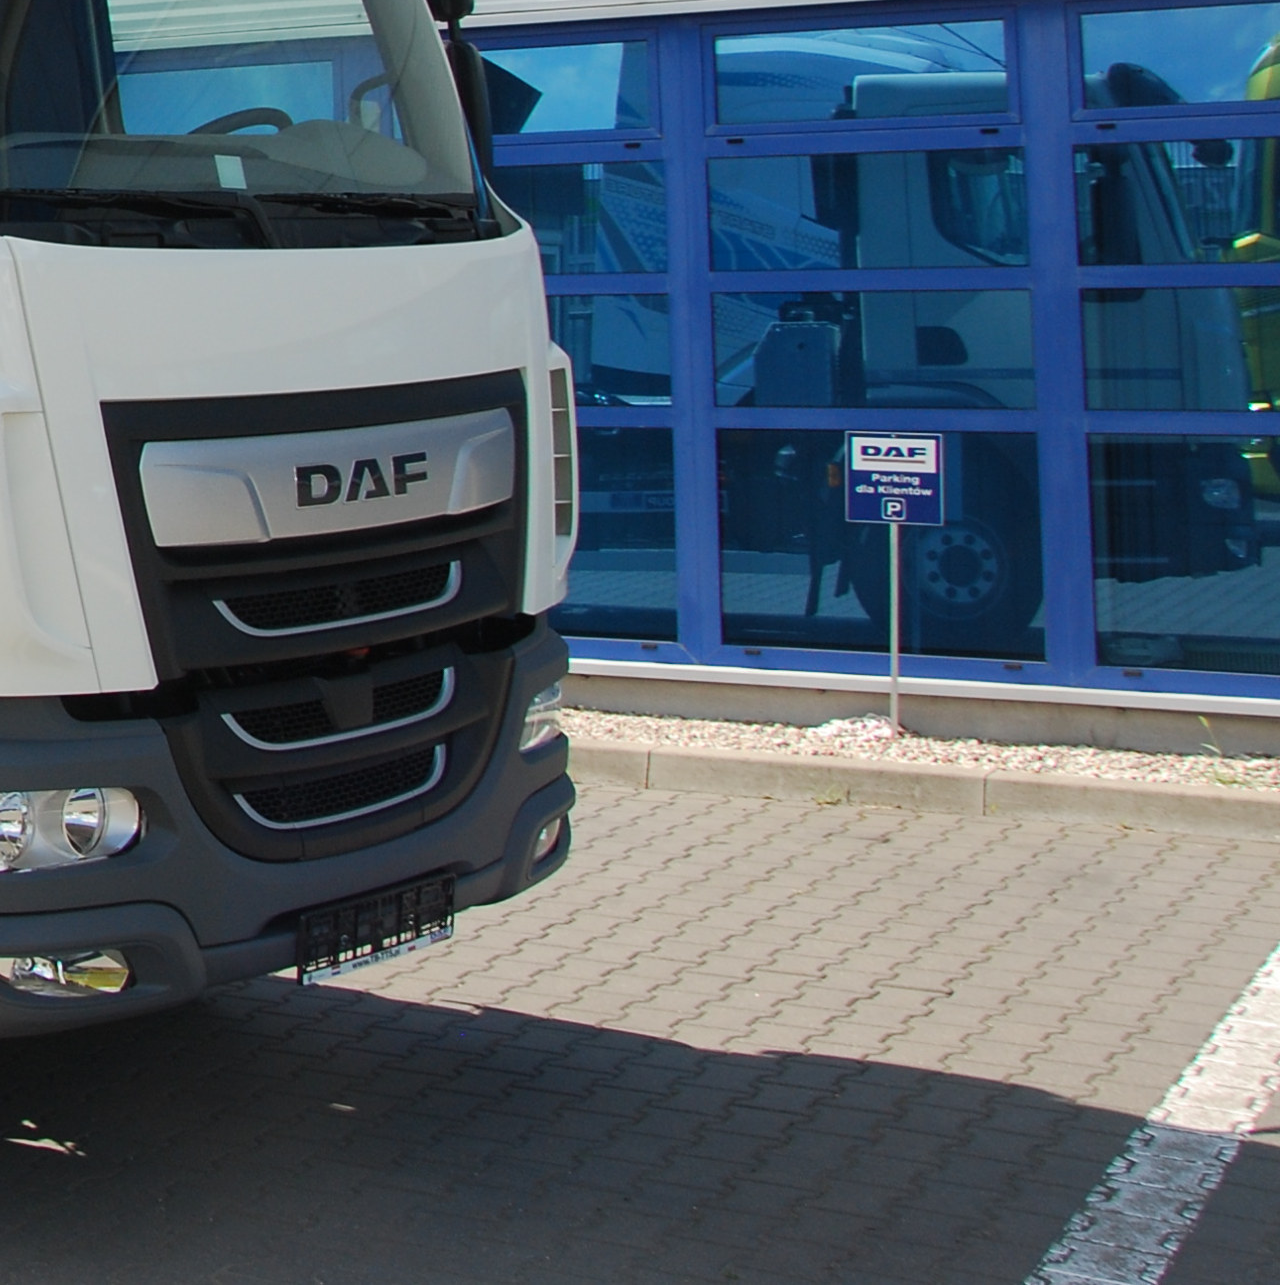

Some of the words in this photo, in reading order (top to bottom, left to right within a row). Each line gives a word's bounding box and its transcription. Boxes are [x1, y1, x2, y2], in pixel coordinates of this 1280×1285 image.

[860, 445, 927, 458] DAF
[294, 451, 428, 509] DAF
[871, 473, 921, 485] Parking
[855, 484, 875, 494] dla
[878, 485, 933, 496] Klientów
[886, 502, 902, 516] P
